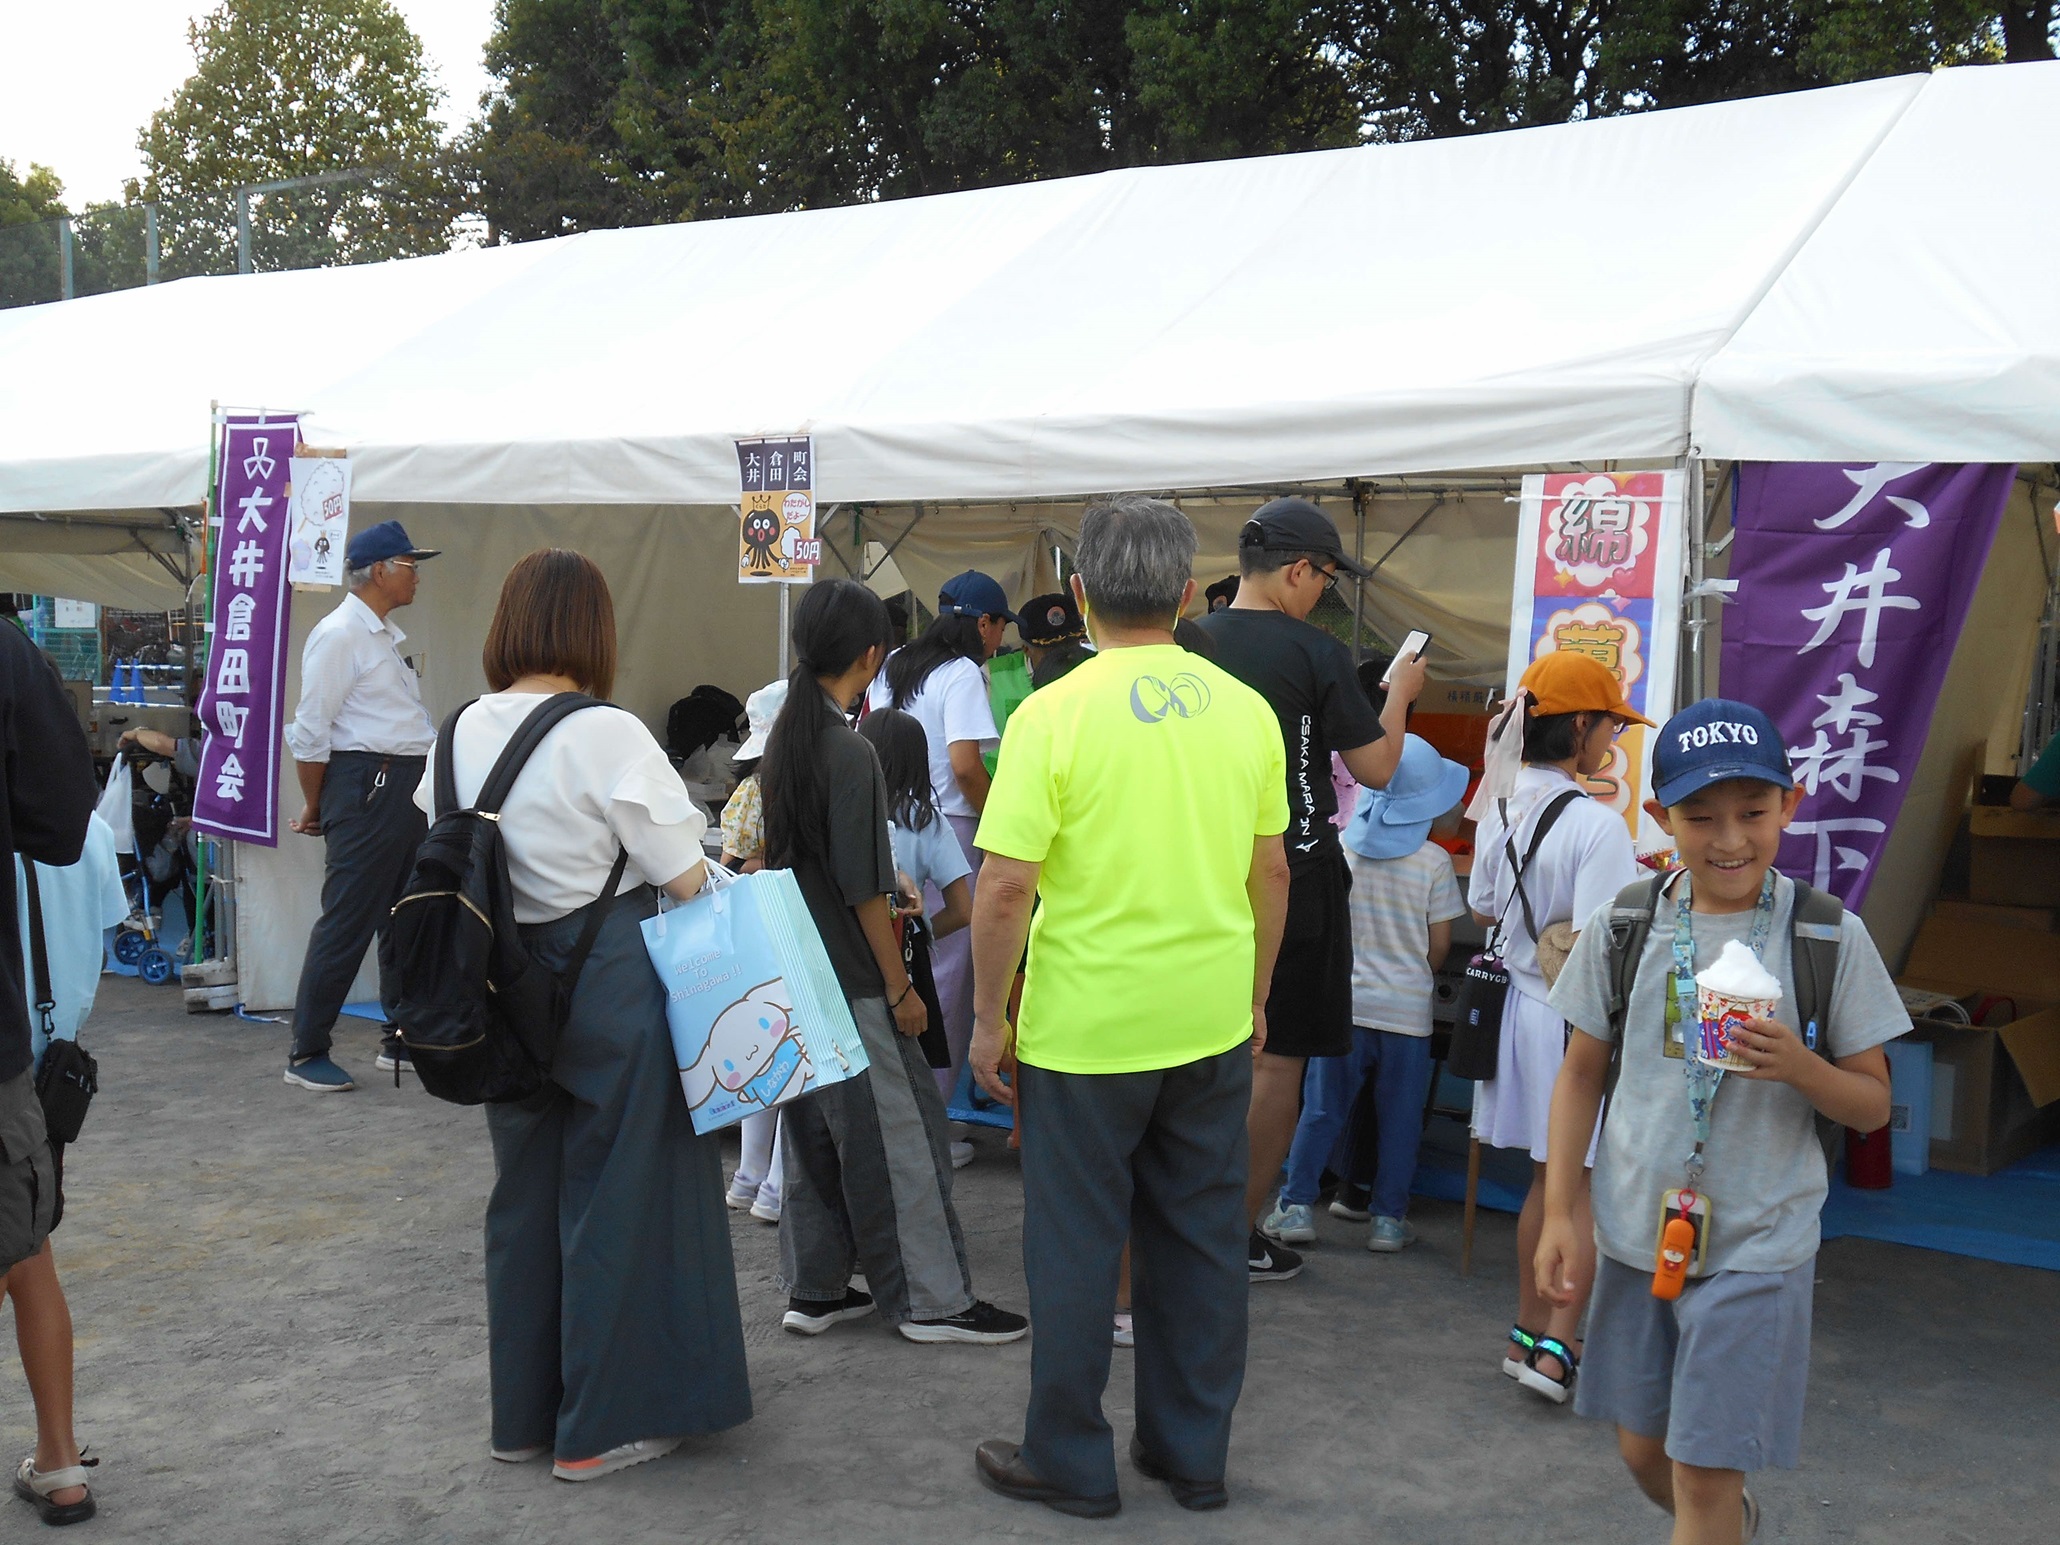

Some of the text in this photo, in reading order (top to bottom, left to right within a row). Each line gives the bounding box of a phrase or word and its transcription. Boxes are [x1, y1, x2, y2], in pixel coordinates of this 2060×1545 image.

[745, 452, 761, 483] 大井
[769, 450, 783, 482] 倉田
[793, 451, 807, 482] 町会
[796, 541, 820, 561] 50円
[215, 485, 273, 803] 大井倉田町会
[1678, 721, 1759, 753] TOKYO
[670, 971, 731, 1003] Shinagawa
[693, 967, 708, 979] To
[760, 1060, 790, 1097] しながわ
